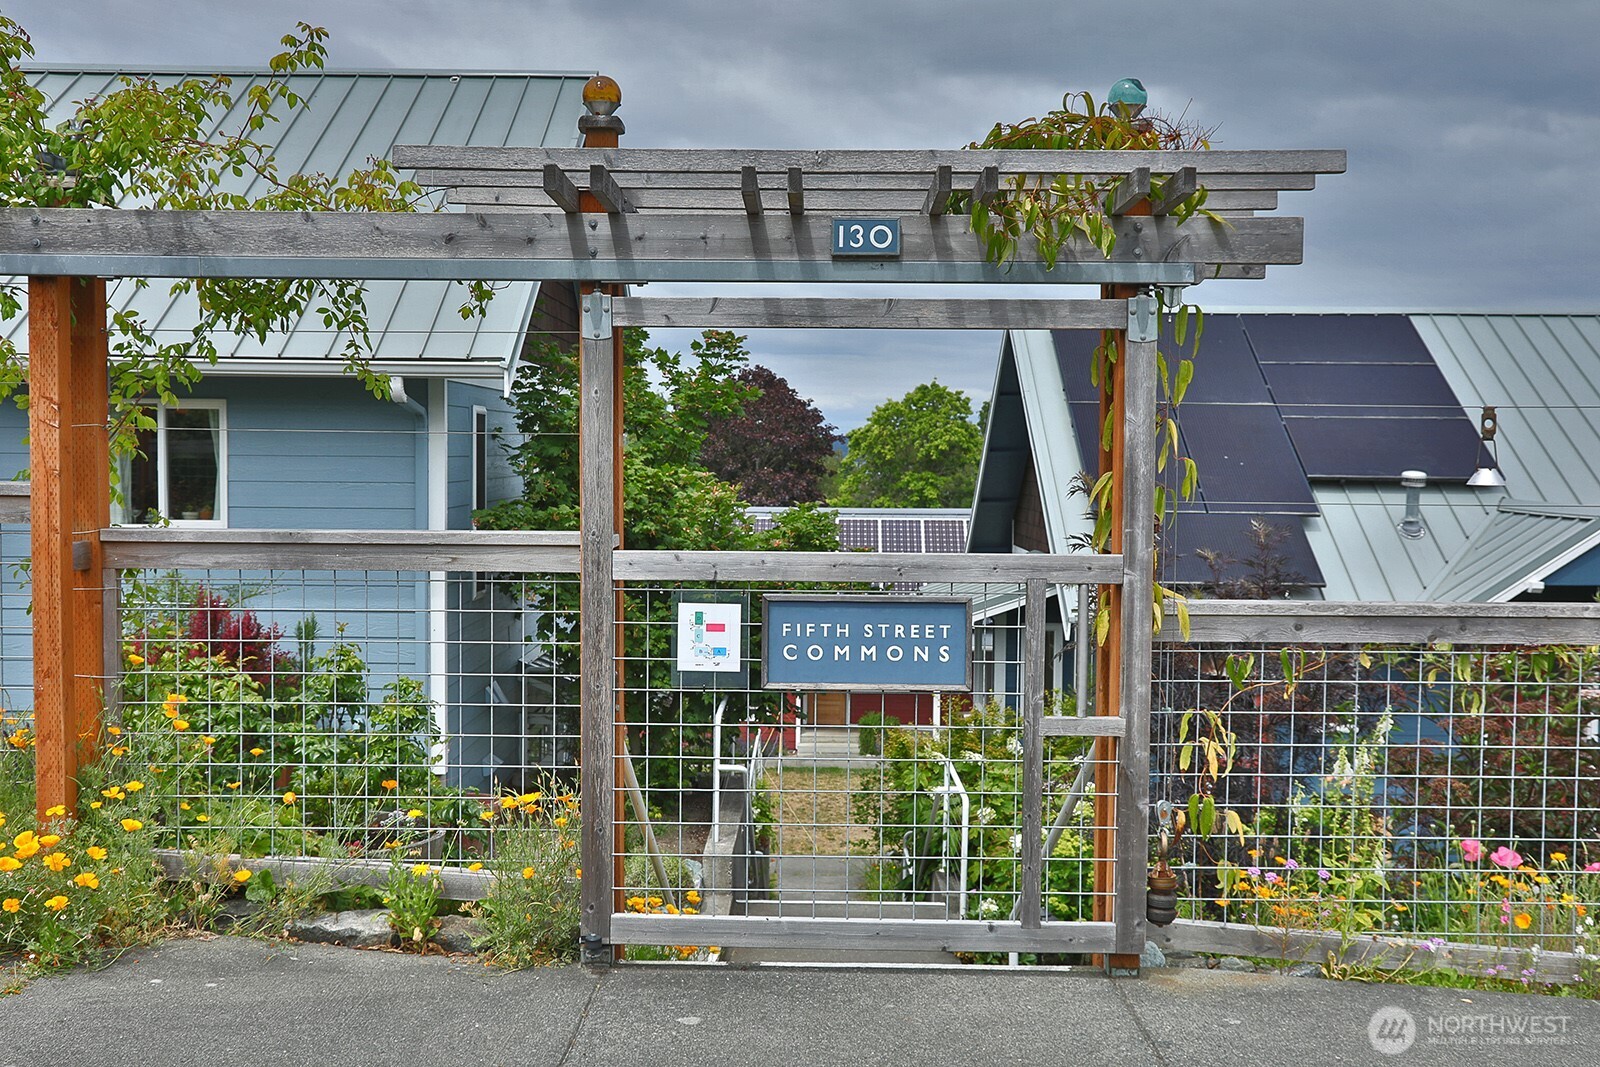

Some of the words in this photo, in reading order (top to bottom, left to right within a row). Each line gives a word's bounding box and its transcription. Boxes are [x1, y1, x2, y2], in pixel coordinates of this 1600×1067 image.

[838, 224, 893, 249] 130
[782, 623, 849, 638] FIFTH
[863, 623, 951, 639] STREET
[782, 644, 950, 663] COMMONS
